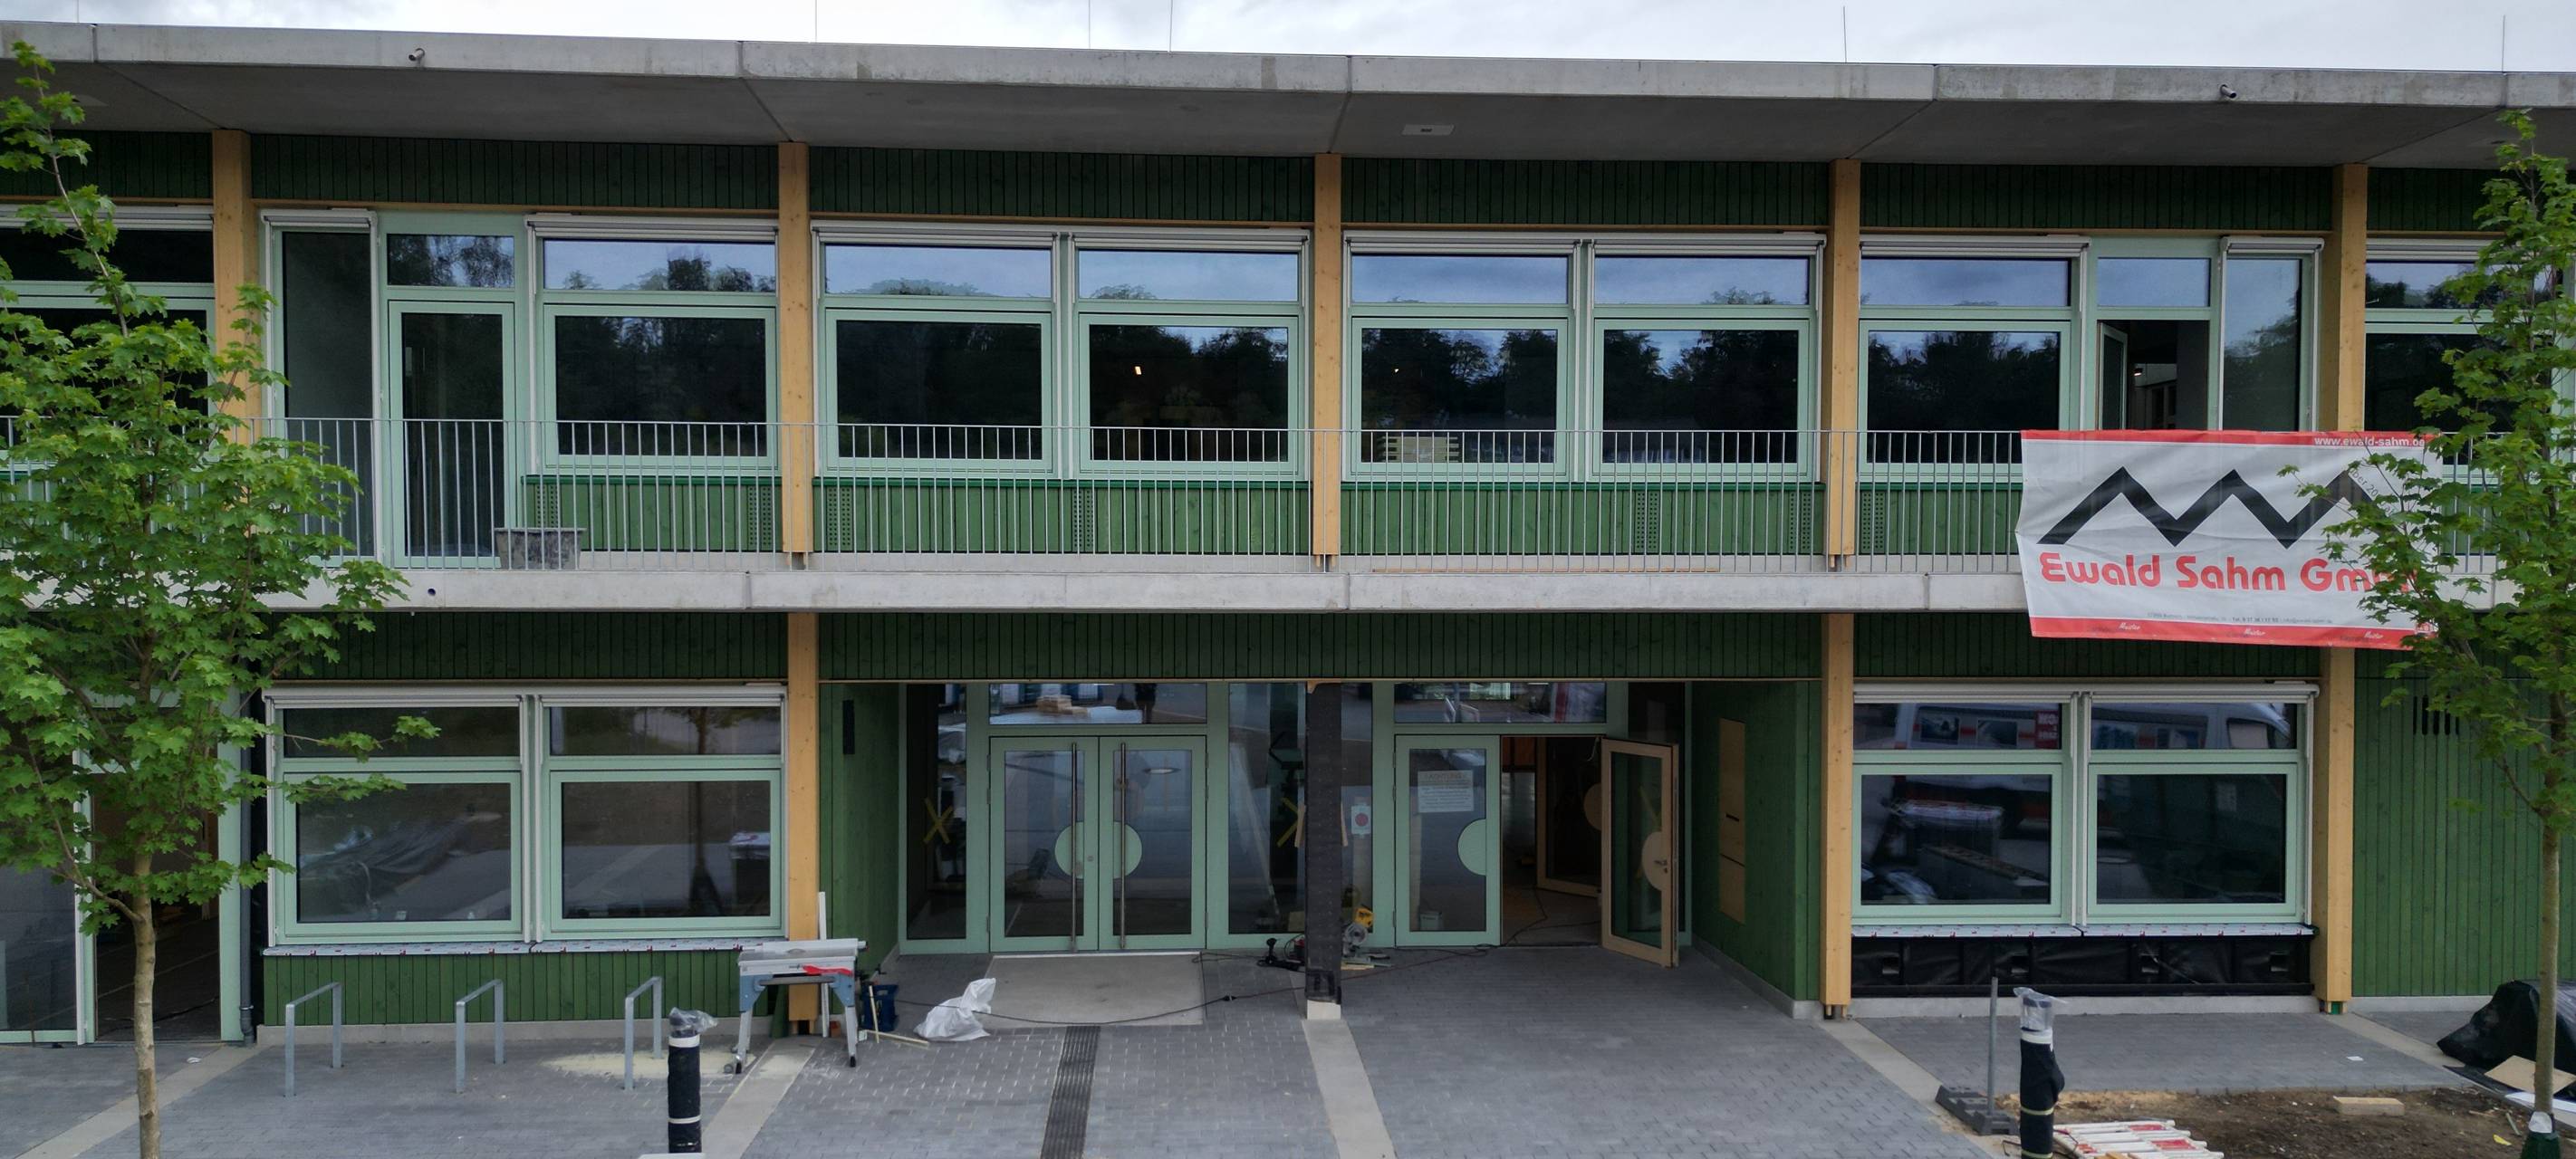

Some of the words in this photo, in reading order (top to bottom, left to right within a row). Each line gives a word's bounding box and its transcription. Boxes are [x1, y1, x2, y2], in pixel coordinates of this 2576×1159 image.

[2039, 552, 2161, 588] Ewald
[2177, 556, 2286, 591] Sahm
[2301, 558, 2417, 592] Gm
